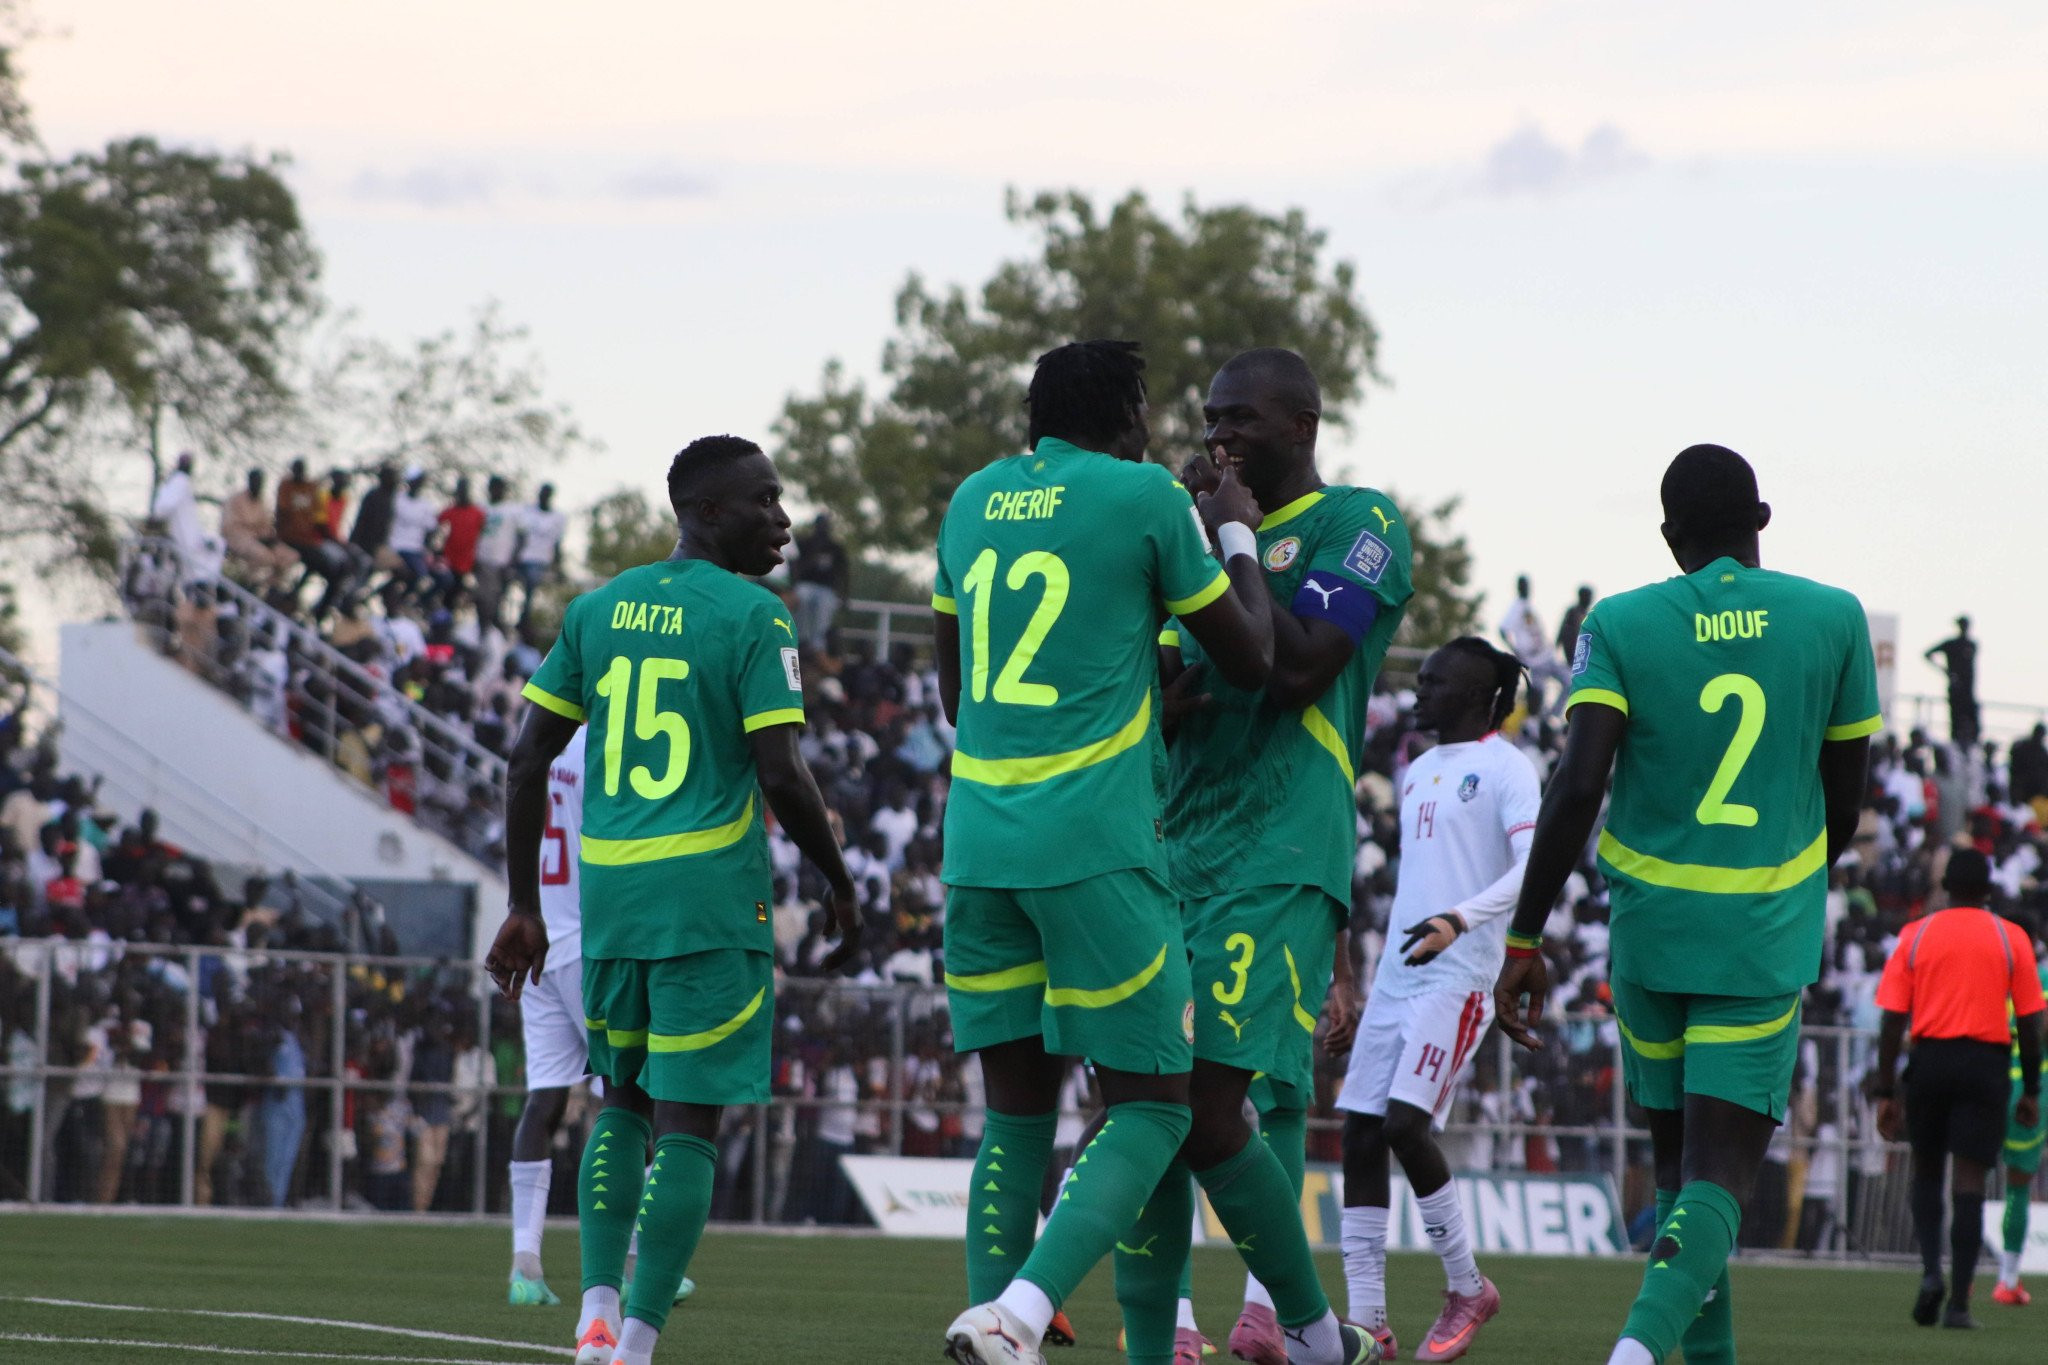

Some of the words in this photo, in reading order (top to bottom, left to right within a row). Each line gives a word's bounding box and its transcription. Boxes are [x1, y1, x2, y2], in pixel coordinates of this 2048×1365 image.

[985, 486, 1066, 521] CHERIF
[611, 601, 683, 636] DIATTA
[962, 548, 1070, 707] 12
[1695, 609, 1769, 643] DIOUF
[596, 656, 691, 800] 15
[1695, 673, 1767, 828] 2
[1415, 801, 1437, 839] 14
[1212, 932, 1255, 1005] 3
[1414, 1042, 1447, 1083] 14
